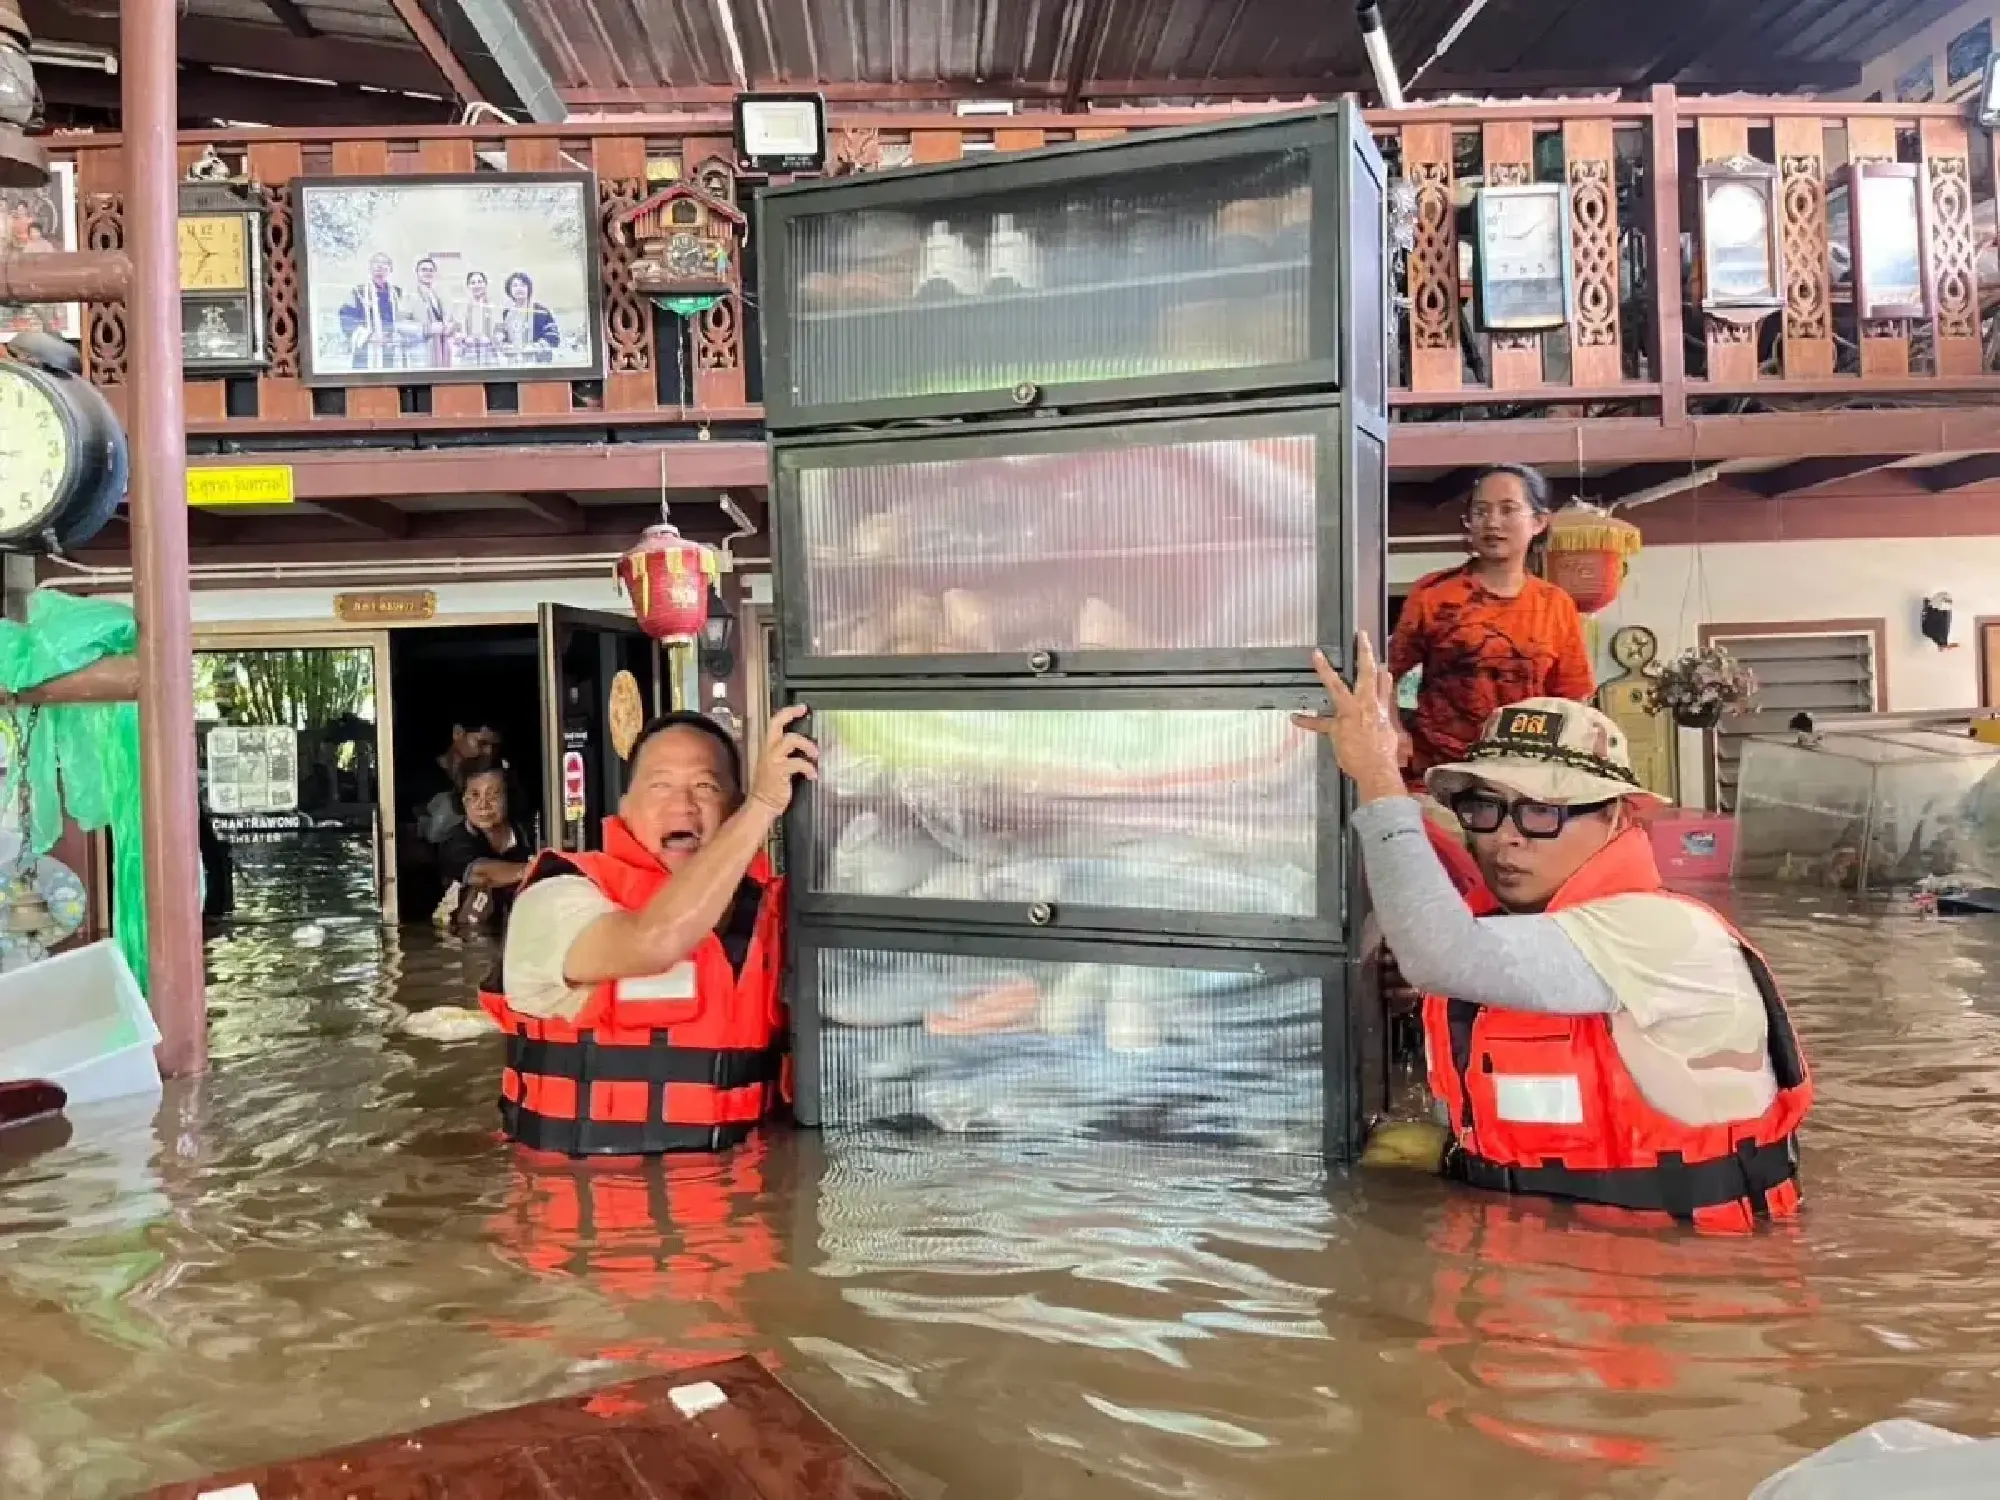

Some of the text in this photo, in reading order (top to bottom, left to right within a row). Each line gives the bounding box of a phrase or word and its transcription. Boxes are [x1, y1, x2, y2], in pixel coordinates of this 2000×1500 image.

[17, 389, 24, 408] 1
[34, 411, 49, 428] 2
[47, 440, 61, 458] 3
[40, 468, 54, 488] 4
[19, 492, 33, 511] 5
[1510, 712, 1548, 736] อส.
[211, 816, 299, 829] CHANTRAWONG
